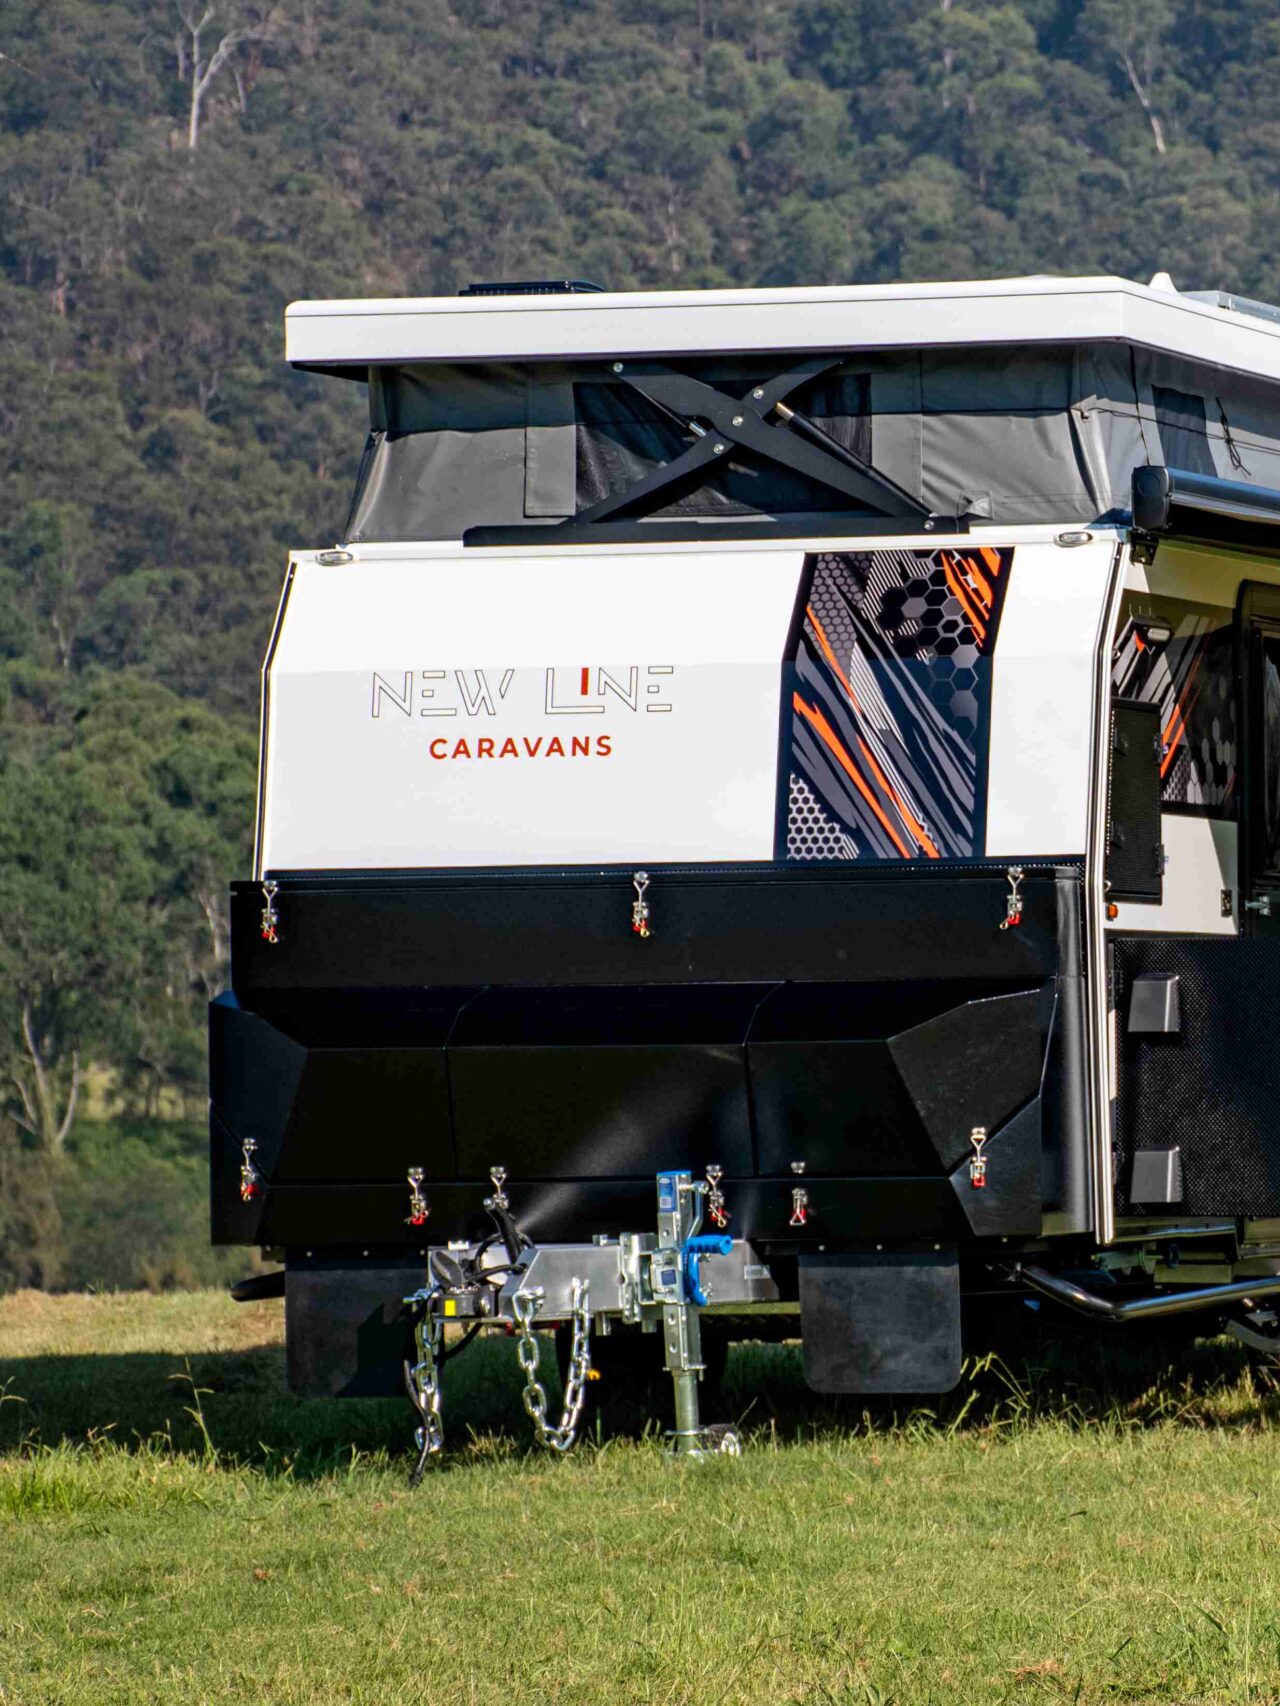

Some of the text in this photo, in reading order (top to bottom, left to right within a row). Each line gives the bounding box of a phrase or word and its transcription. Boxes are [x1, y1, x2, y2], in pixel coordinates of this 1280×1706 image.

[371, 665, 674, 718] NEW LINE
[429, 735, 612, 760] CARAVANS
